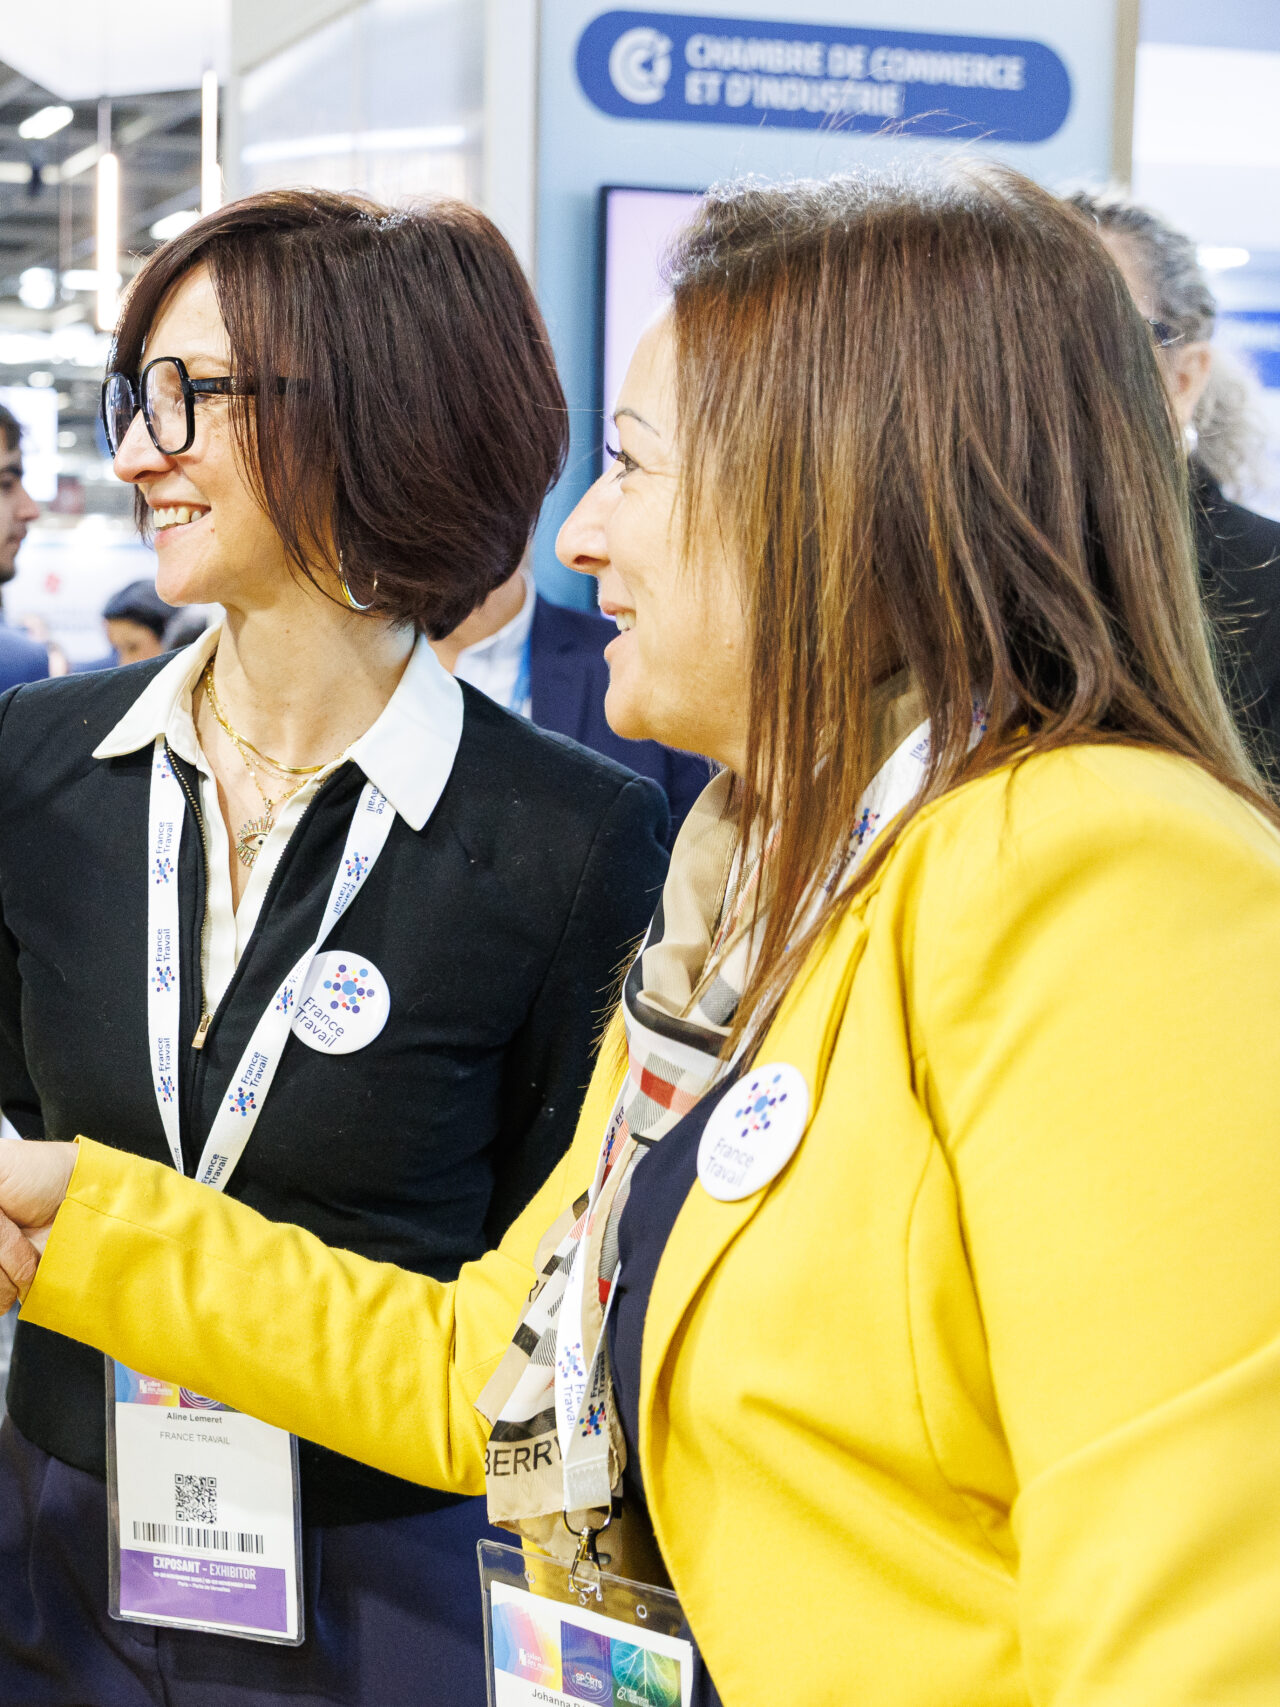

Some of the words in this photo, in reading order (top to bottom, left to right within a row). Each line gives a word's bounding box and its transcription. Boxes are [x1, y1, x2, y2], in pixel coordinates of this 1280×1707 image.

[685, 34, 825, 76] CHAMBRE
[828, 44, 868, 80] DE
[870, 46, 1025, 91] COMMERCE
[685, 71, 721, 105] ET
[724, 73, 904, 116] D'INDUSTRIE
[156, 821, 165, 854] France
[163, 822, 174, 853] Travail
[333, 882, 350, 914] Travail
[163, 928, 171, 962] Travail
[294, 1007, 337, 1048] Travail
[303, 997, 344, 1037] France
[241, 1051, 260, 1084] France
[250, 1055, 269, 1087] Travail
[201, 1153, 219, 1184] France
[714, 1138, 754, 1168] France
[208, 1156, 229, 1185] Travail
[706, 1155, 747, 1188] Travail
[167, 1412, 187, 1421] Aline
[190, 1413, 223, 1424] Lemeret
[160, 1431, 194, 1442] FRANCE
[197, 1434, 230, 1445] TRAVAIL
[153, 1556, 200, 1573] EXPOSANT
[209, 1563, 256, 1580] EXHIBITOR
